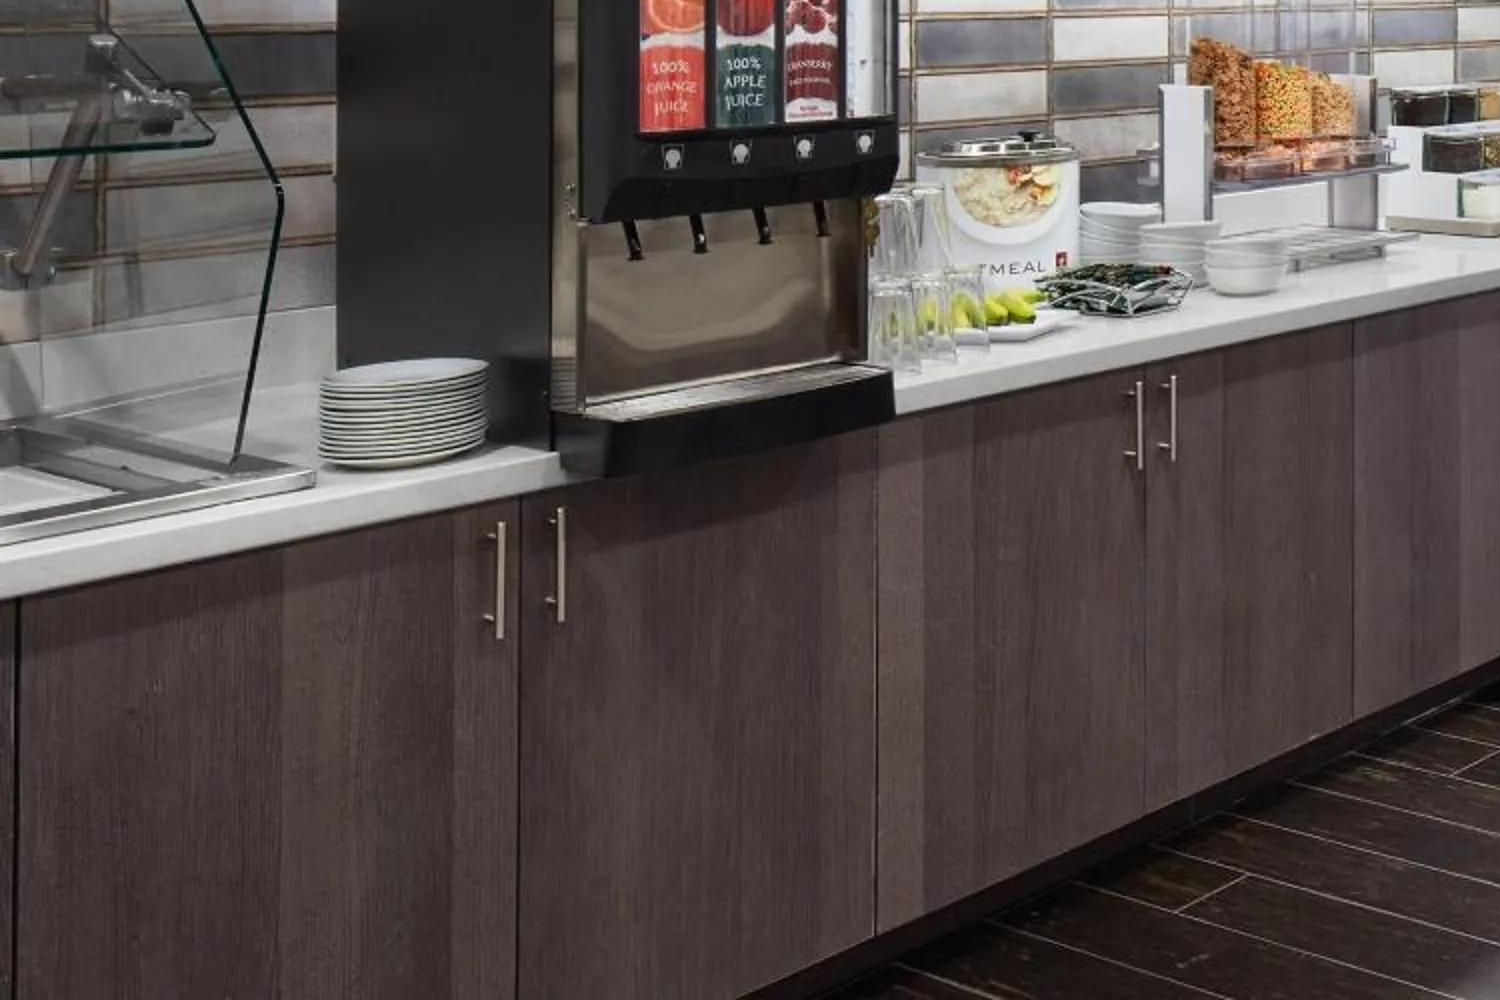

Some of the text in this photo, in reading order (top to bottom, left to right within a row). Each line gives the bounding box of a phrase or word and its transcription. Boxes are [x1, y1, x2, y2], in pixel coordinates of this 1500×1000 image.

[651, 59, 689, 75] 100%
[727, 56, 761, 71] 100%
[646, 80, 697, 96] ORANGE
[724, 75, 767, 90] APPLE
[654, 100, 689, 117] JUICE
[724, 93, 764, 112] JUICE
[979, 261, 1046, 277] TMEAL
